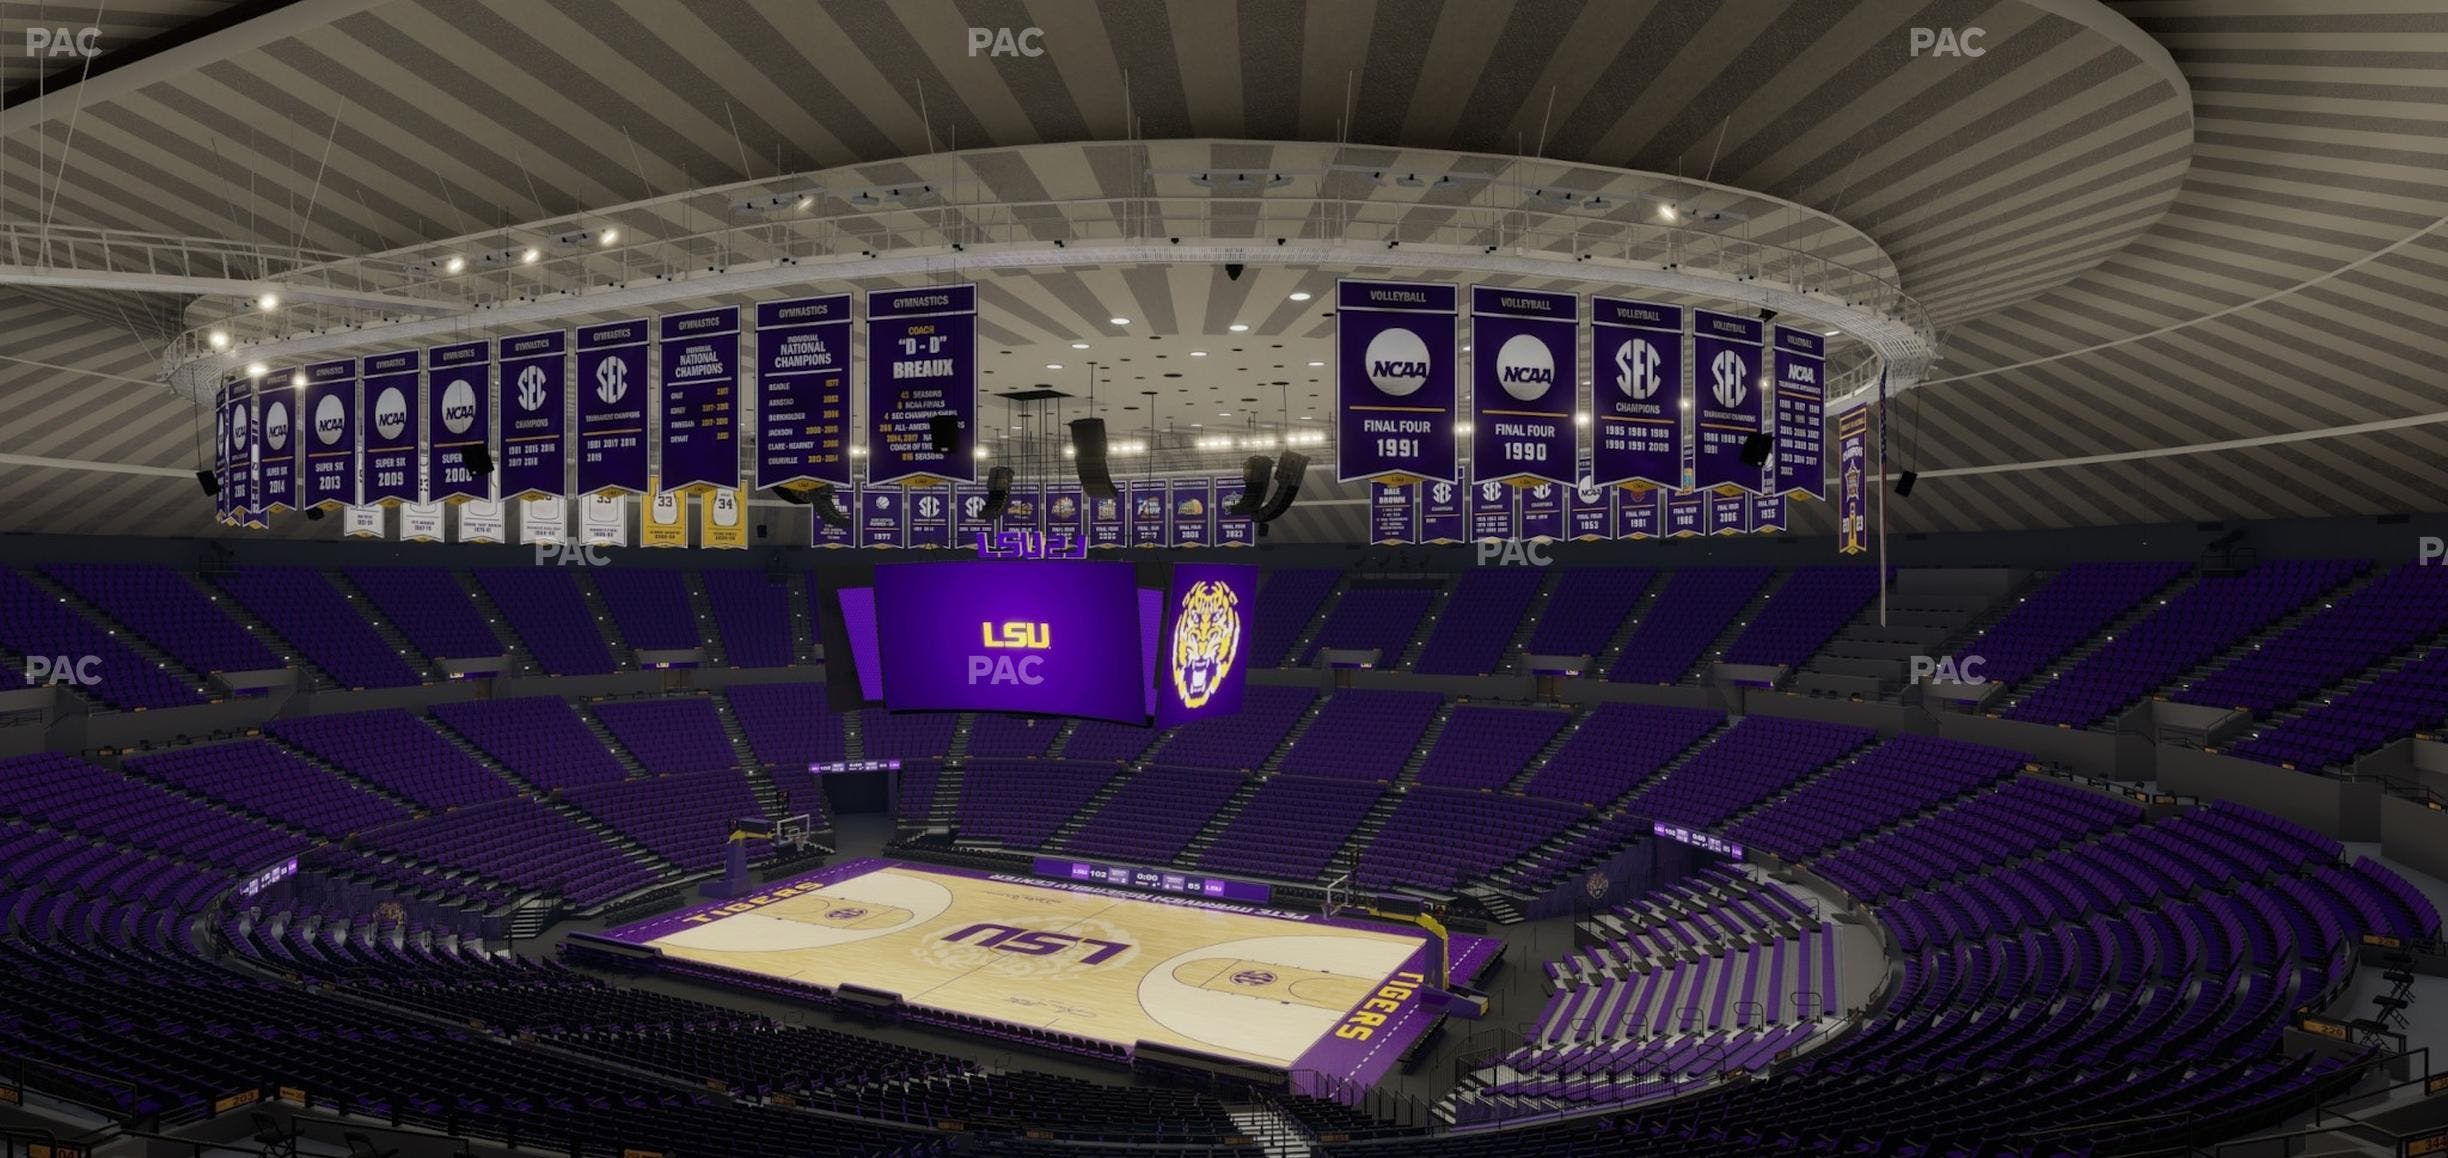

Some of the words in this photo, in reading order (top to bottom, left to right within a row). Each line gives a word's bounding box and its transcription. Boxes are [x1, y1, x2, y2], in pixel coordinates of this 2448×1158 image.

[893, 295, 949, 309] GYMNASTICS
[1370, 290, 1426, 303] VOLLEYBALL
[1501, 297, 1551, 310] VOLLEYBALL
[779, 305, 828, 319] GYMNASTICS
[1616, 308, 1661, 321] VOLLEYBALL
[678, 317, 720, 331] GYMNASTICS
[908, 325, 935, 335] COACH
[1713, 320, 1746, 334] VOLLEYBALL
[593, 328, 631, 342] GYMNASTICS
[515, 339, 549, 351] GYMNASTICS
[780, 341, 826, 355] NATIONAL
[680, 352, 718, 366] NATIONAL
[775, 353, 832, 368] CHAMPIONS
[675, 363, 723, 378] CHAMPIONS
[893, 359, 953, 379] BREAUX
[1373, 361, 1427, 378] NCAA
[1503, 366, 1552, 384] NCAA
[1615, 338, 1661, 400] SEC
[1788, 363, 1814, 383] NCAA
[596, 355, 628, 404] SEC
[1711, 349, 1747, 408] SEC
[517, 365, 547, 411] SEC
[445, 405, 474, 421] NCAA
[1616, 402, 1661, 415] CHAMPIONS
[319, 418, 344, 432] NCAA
[379, 412, 405, 427] NCAA
[515, 418, 549, 429] CHAMPIONS
[1364, 420, 1398, 432] FINAL
[1399, 420, 1431, 433] FOUR
[269, 423, 287, 438] NCAA
[1495, 423, 1526, 436] FINAL
[1527, 425, 1555, 437] FOUR
[1605, 426, 1625, 436] 1985
[1628, 426, 1647, 437] 1986
[1650, 427, 1669, 438] 1989
[1377, 439, 1418, 457] 1991
[1505, 442, 1547, 461] 1990
[1605, 439, 1625, 449] 1990
[1628, 440, 1646, 450] 1991
[1649, 442, 1669, 453] 2009
[375, 458, 394, 469] SUPER
[396, 457, 406, 467] SIX
[442, 453, 462, 464] SUPER
[315, 462, 333, 472] SUPER
[334, 461, 344, 471] SIX
[319, 476, 341, 490] 2013
[378, 472, 404, 487] 2009
[270, 481, 285, 494] 2014
[1383, 488, 1400, 496] DALE
[1432, 482, 1451, 503] SEC
[1482, 481, 1501, 501] SEC
[1581, 489, 1601, 497] NCAA
[658, 495, 673, 507] 33
[718, 498, 732, 510] 34
[1581, 521, 1599, 529] 1953
[976, 532, 1044, 559] LSU
[982, 621, 1050, 649] LSU
[1090, 870, 1107, 878] 102
[1137, 873, 1158, 882] 0:00
[682, 881, 824, 923] TIGERS
[940, 923, 1132, 965] LSU
[1335, 972, 1424, 1041] TIGERS
